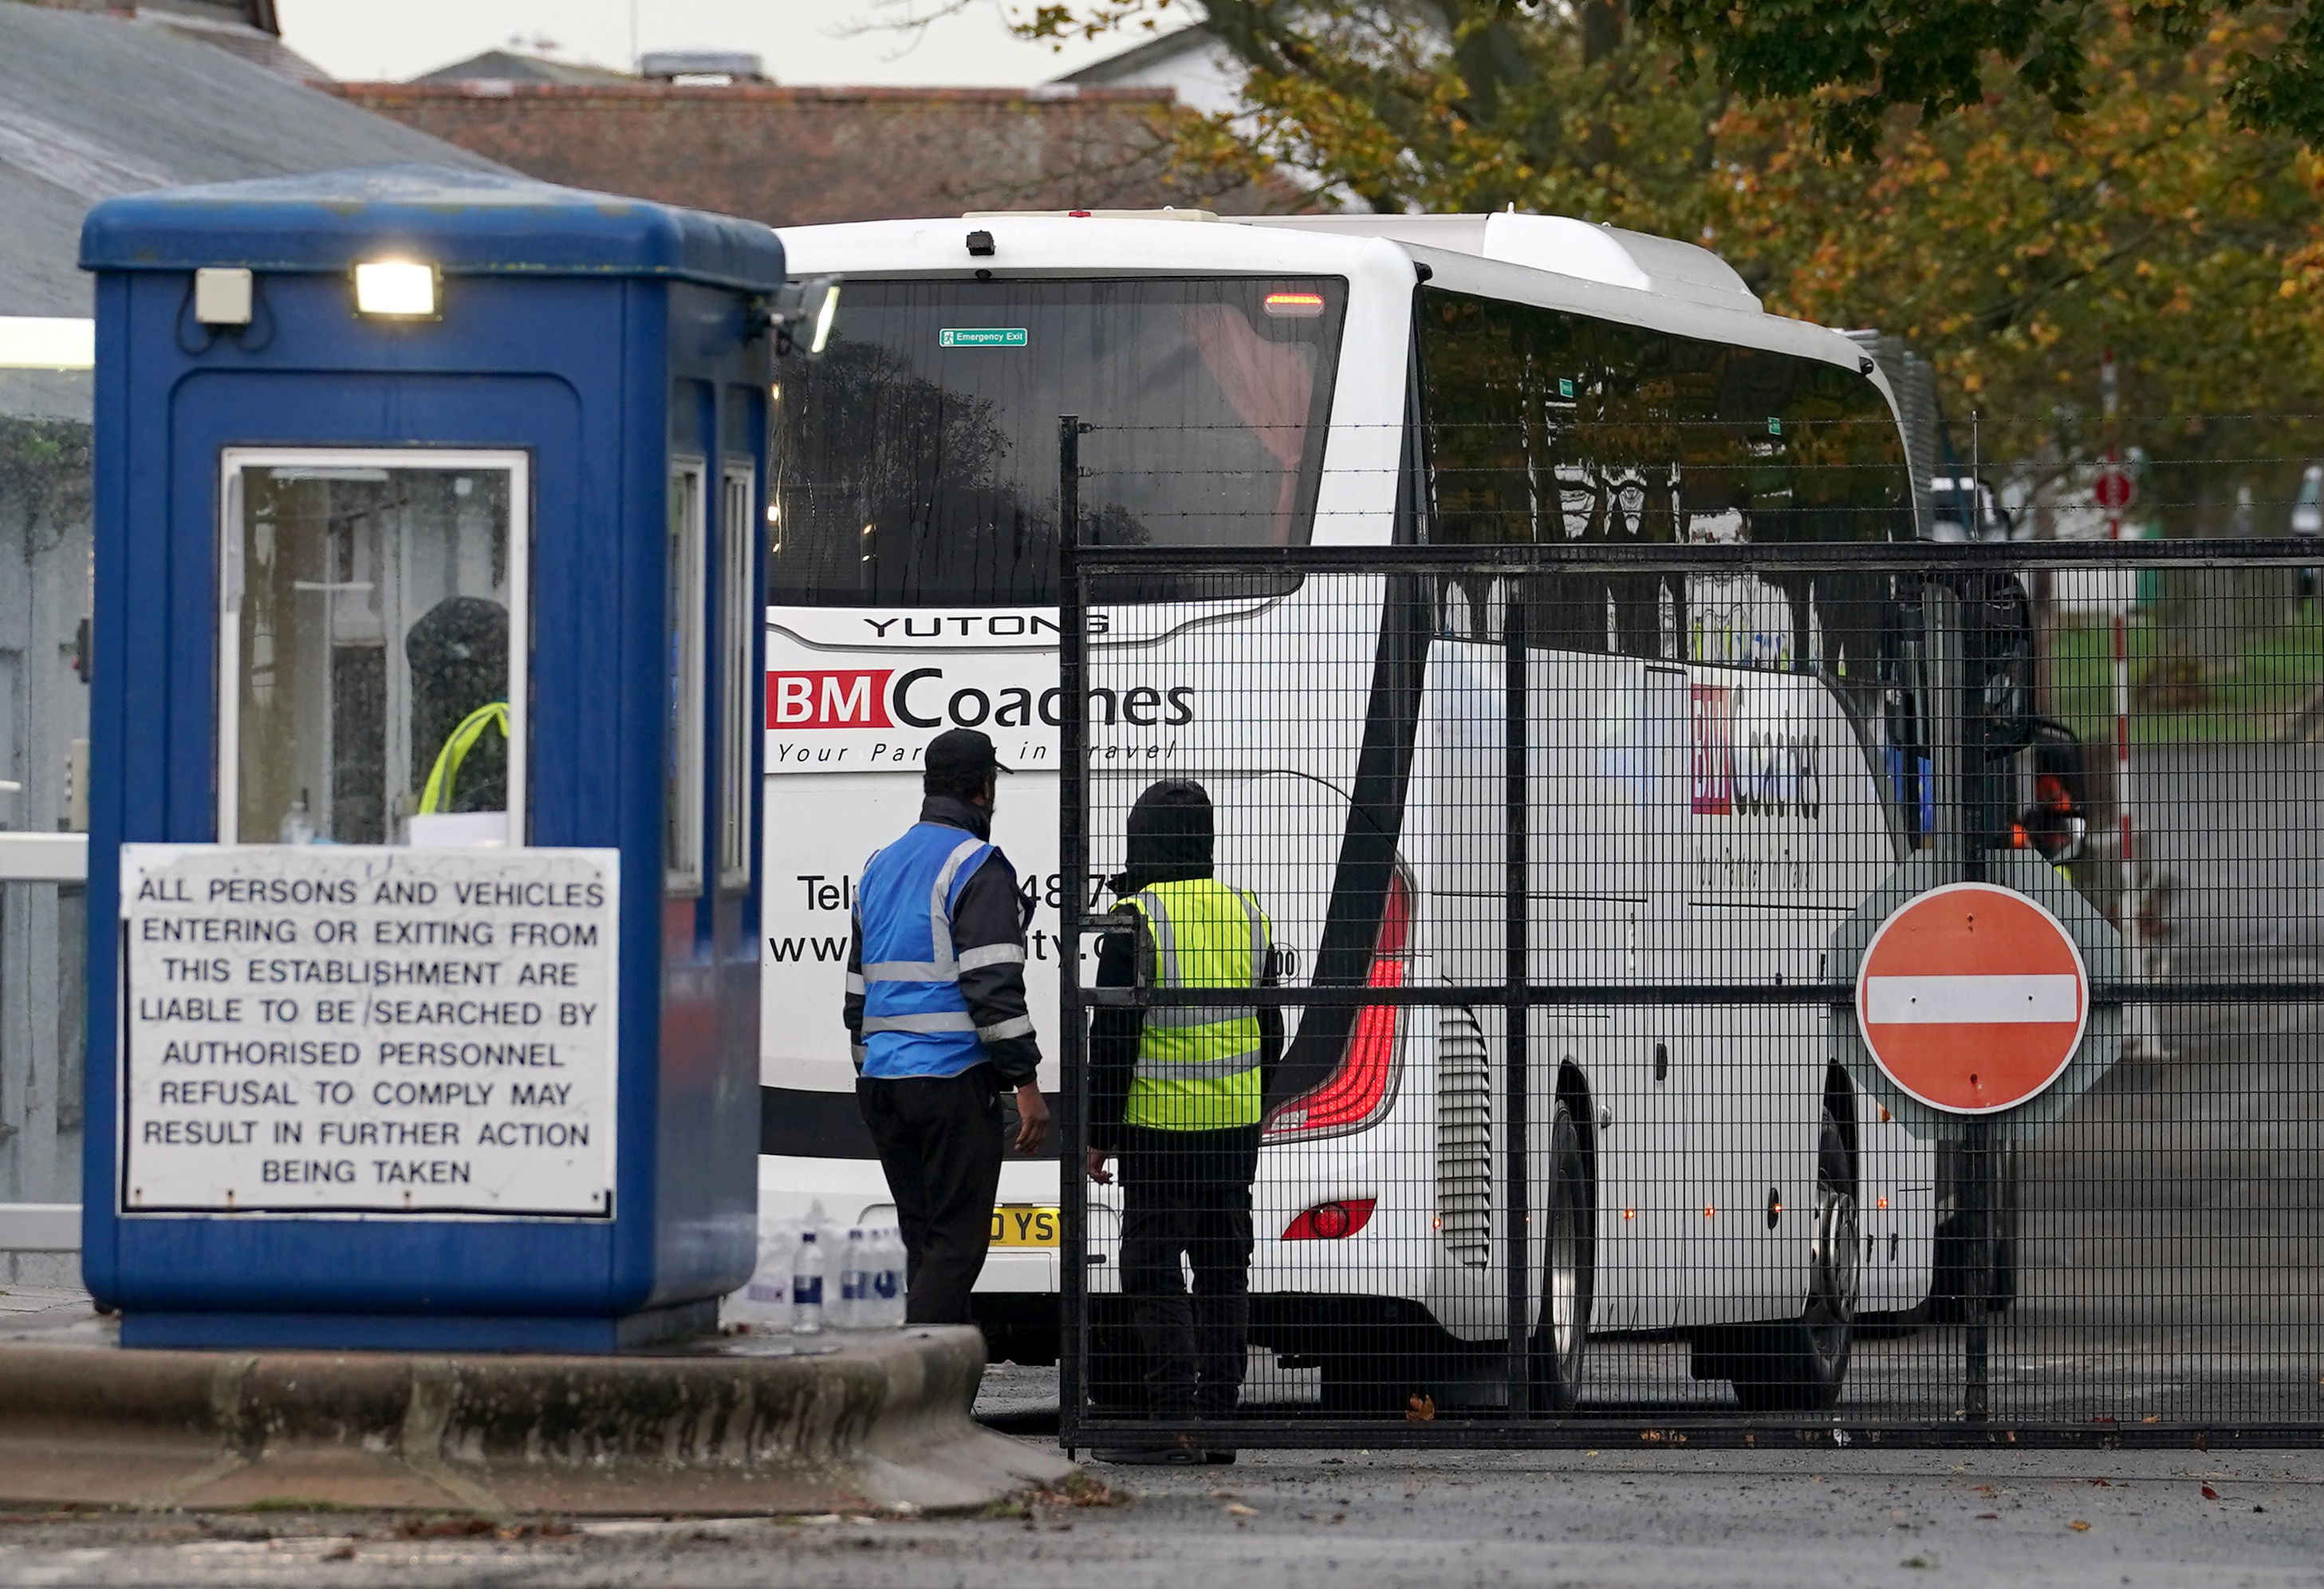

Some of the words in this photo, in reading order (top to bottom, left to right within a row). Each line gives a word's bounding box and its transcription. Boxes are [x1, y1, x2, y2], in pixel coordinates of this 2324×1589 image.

[957, 333, 1003, 342] Emergency
[1006, 332, 1022, 341] Exit
[776, 676, 872, 723] BM
[779, 743, 848, 762] Your
[1019, 740, 1046, 759] in
[1088, 740, 1176, 759] ravel
[139, 878, 193, 901] ALL
[209, 878, 357, 903] PERSONS
[375, 881, 436, 905] AND
[455, 881, 605, 907] VEHICLES
[144, 918, 296, 943] ENTERING
[315, 920, 356, 944] OR
[376, 921, 494, 945] EXITING
[511, 922, 597, 946] FROM
[163, 958, 230, 982] THIS
[249, 959, 502, 985] ESTABLISHMENT
[519, 962, 578, 986] ARE
[140, 998, 242, 1021] LIABLE
[260, 1000, 298, 1022] TO
[317, 1000, 354, 1023] BE
[375, 1001, 542, 1024] SEARCHED
[560, 1003, 597, 1025] BY
[163, 1041, 360, 1065] AUTHORISED
[380, 1043, 565, 1067] PERSONNEL
[160, 1080, 298, 1105] REFUSAL
[316, 1082, 353, 1105] TO
[373, 1082, 494, 1106] COMPLY
[511, 1082, 572, 1106] MAY
[144, 1121, 258, 1145] RESULT
[274, 1121, 301, 1143] IN
[320, 1122, 459, 1145] FURTHER
[479, 1122, 589, 1146] ACTION
[263, 1160, 355, 1183] BEING
[372, 1161, 470, 1183] TAKEN
[1015, 1212, 1060, 1240] YS
